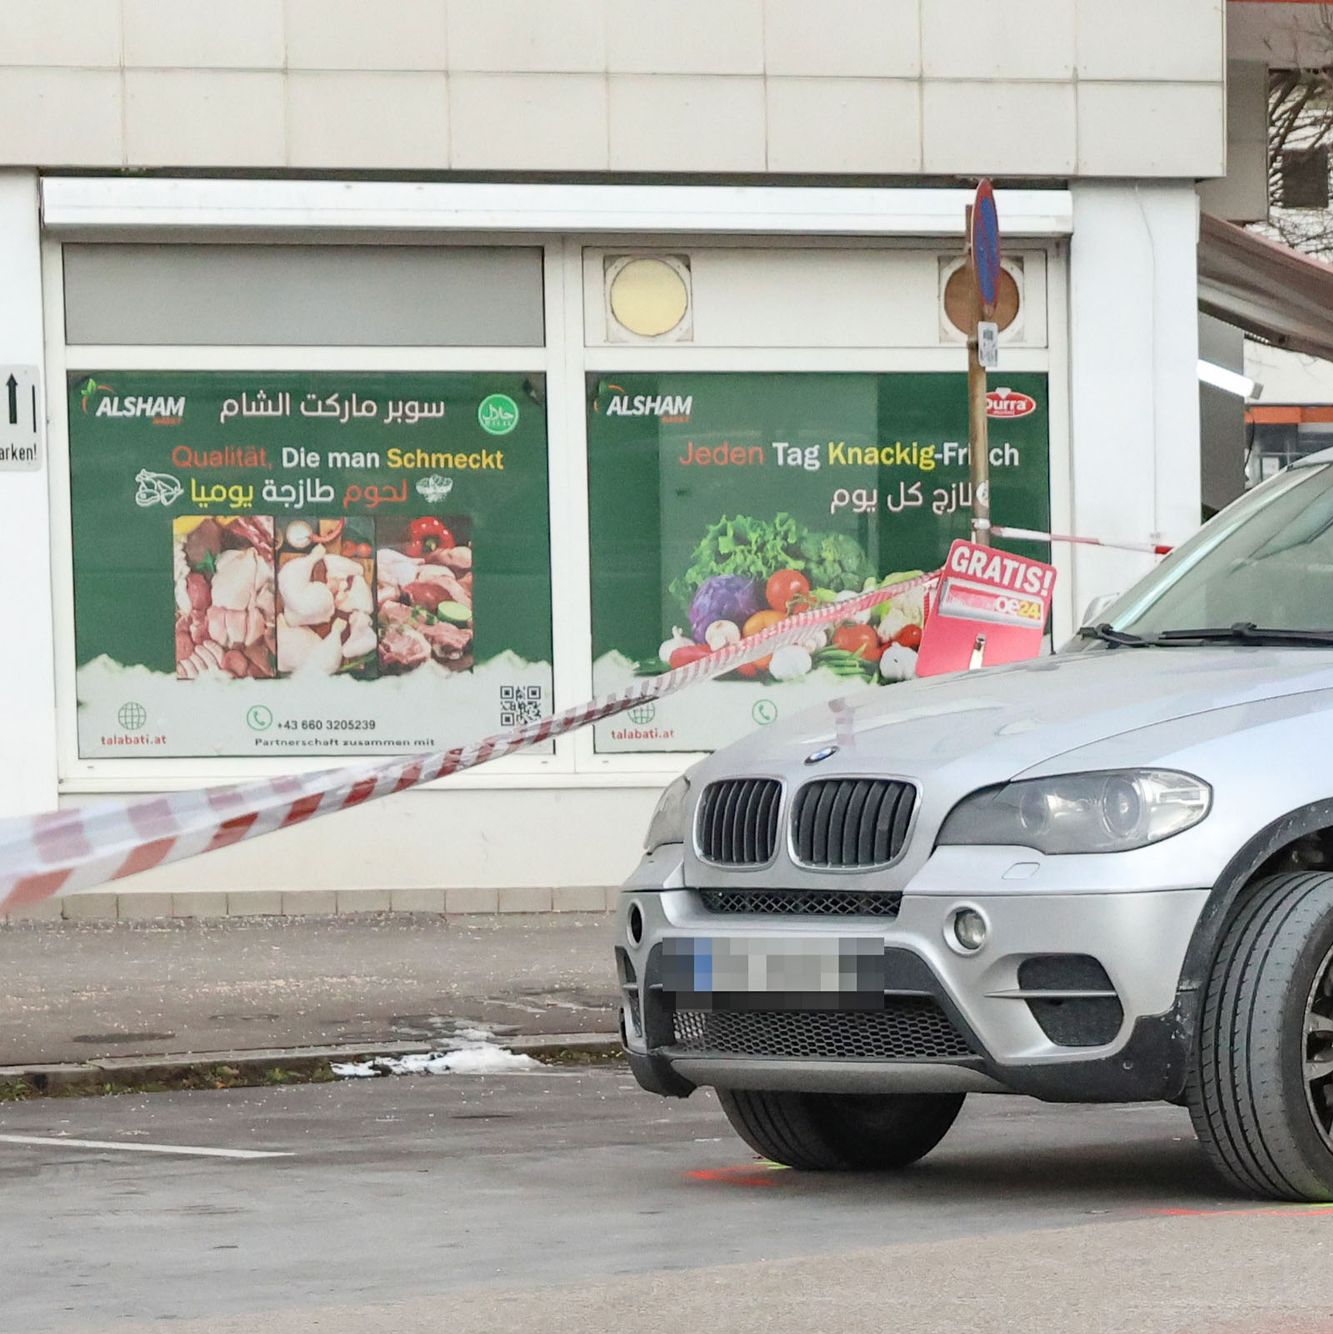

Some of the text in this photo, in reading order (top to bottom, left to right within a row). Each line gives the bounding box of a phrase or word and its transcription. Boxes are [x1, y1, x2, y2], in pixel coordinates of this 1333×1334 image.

[96, 396, 186, 417] ALSHAM
[220, 389, 445, 424] سوبر ماركت الشام
[606, 395, 693, 416] ALSHAM
[172, 445, 505, 470] Qualität, Die man Schmeckt
[679, 441, 1020, 471] Jeden Tag Knackig-Frich
[191, 478, 408, 508] لحوم طازجة يوميا
[830, 488, 878, 514] يوم
[886, 481, 924, 511] كل
[950, 546, 1053, 596] GRATIS!
[278, 720, 376, 730] +43 660 3205239
[611, 728, 674, 740] talabati.at
[101, 735, 167, 745] talabati.at
[255, 738, 339, 746] Partnerschaft
[414, 738, 435, 746] mit
